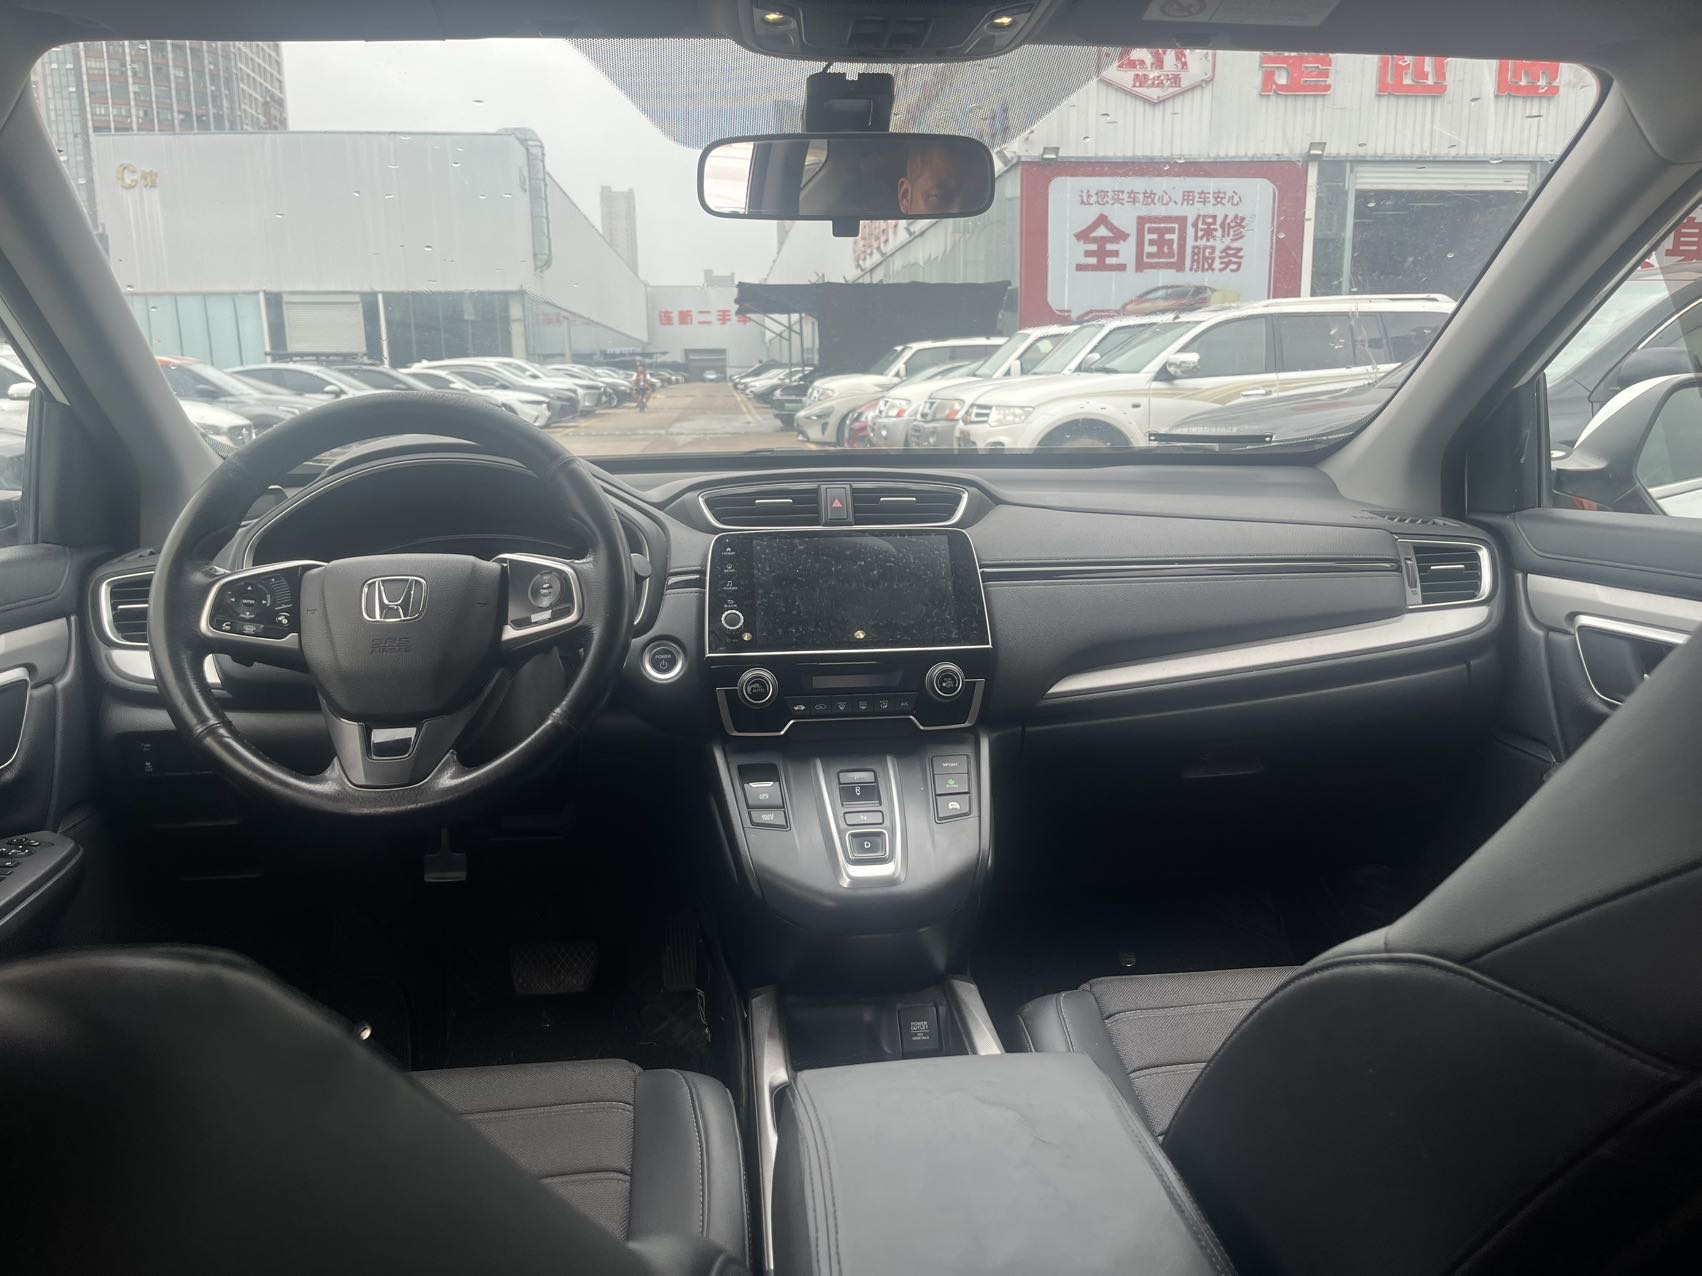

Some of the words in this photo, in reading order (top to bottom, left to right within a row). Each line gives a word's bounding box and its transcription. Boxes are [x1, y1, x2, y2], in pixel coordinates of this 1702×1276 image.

[1079, 189, 1243, 207] 让您买车放心、用车安心
[1190, 213, 1248, 243] 保修
[1073, 213, 1188, 273] 全国
[1190, 244, 1245, 273] 服务
[864, 841, 871, 849] D
